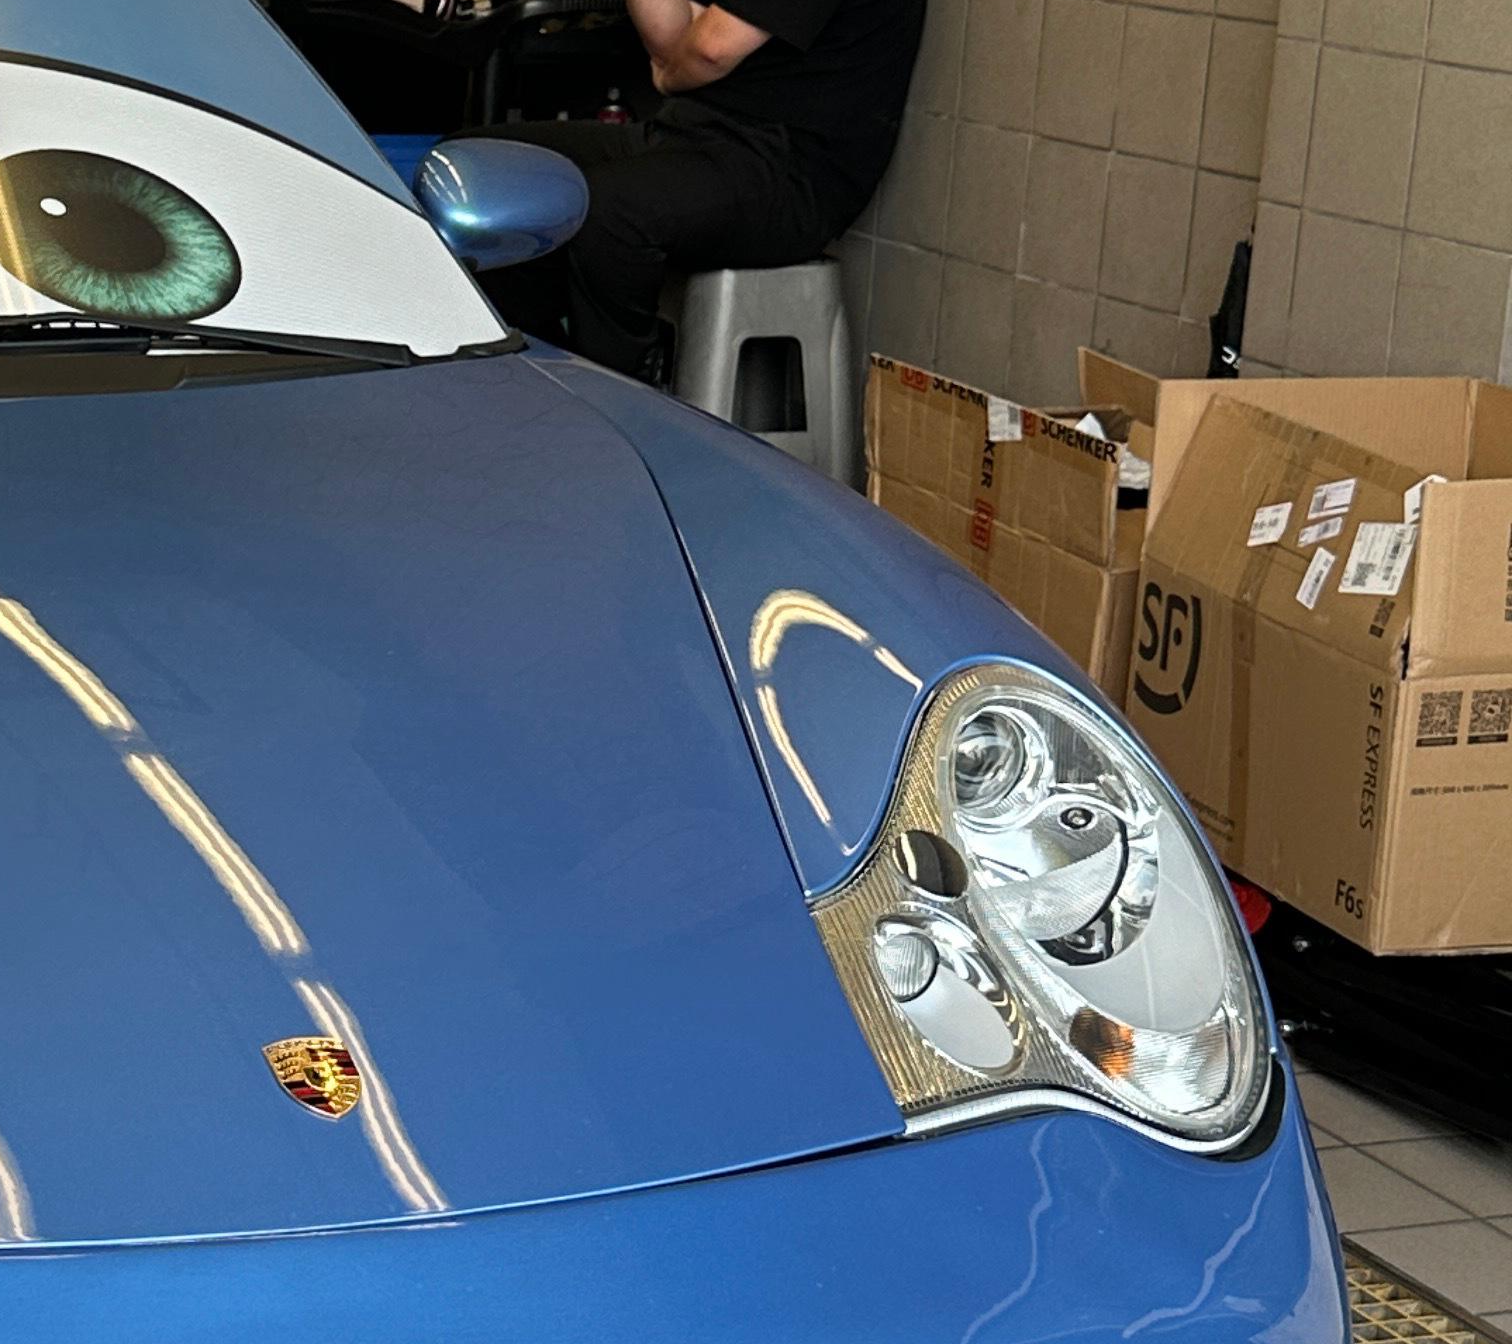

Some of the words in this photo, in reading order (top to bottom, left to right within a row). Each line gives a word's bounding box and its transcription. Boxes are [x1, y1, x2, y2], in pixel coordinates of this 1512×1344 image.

[1040, 418, 1117, 464] SCHENKER
[980, 440, 995, 489] KER
[1369, 683, 1384, 719] SF
[1359, 724, 1382, 832] EXPRESS
[1334, 878, 1364, 920] F6s
